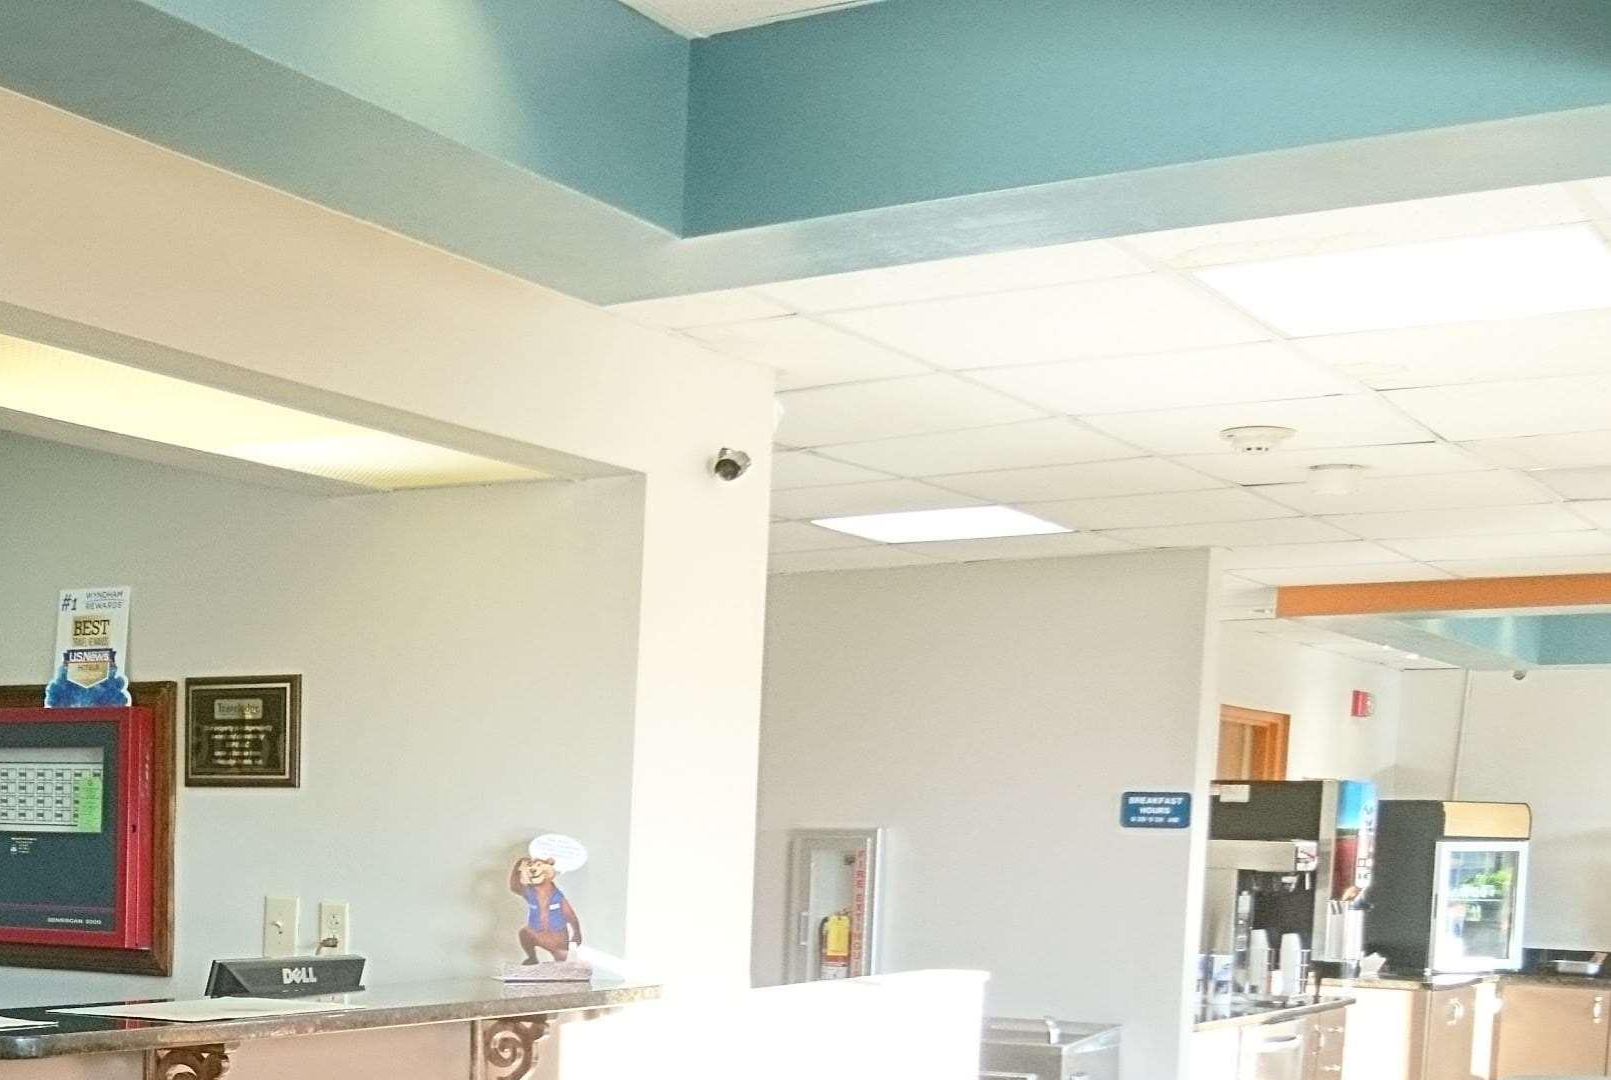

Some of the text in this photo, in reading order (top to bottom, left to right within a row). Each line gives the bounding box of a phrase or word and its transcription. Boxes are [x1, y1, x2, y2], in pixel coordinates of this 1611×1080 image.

[61, 593, 77, 612] #1
[73, 619, 110, 637] BEST
[1127, 796, 1184, 806] BREAKFAST
[1139, 806, 1171, 815] HOURS
[282, 966, 318, 985] DELL
